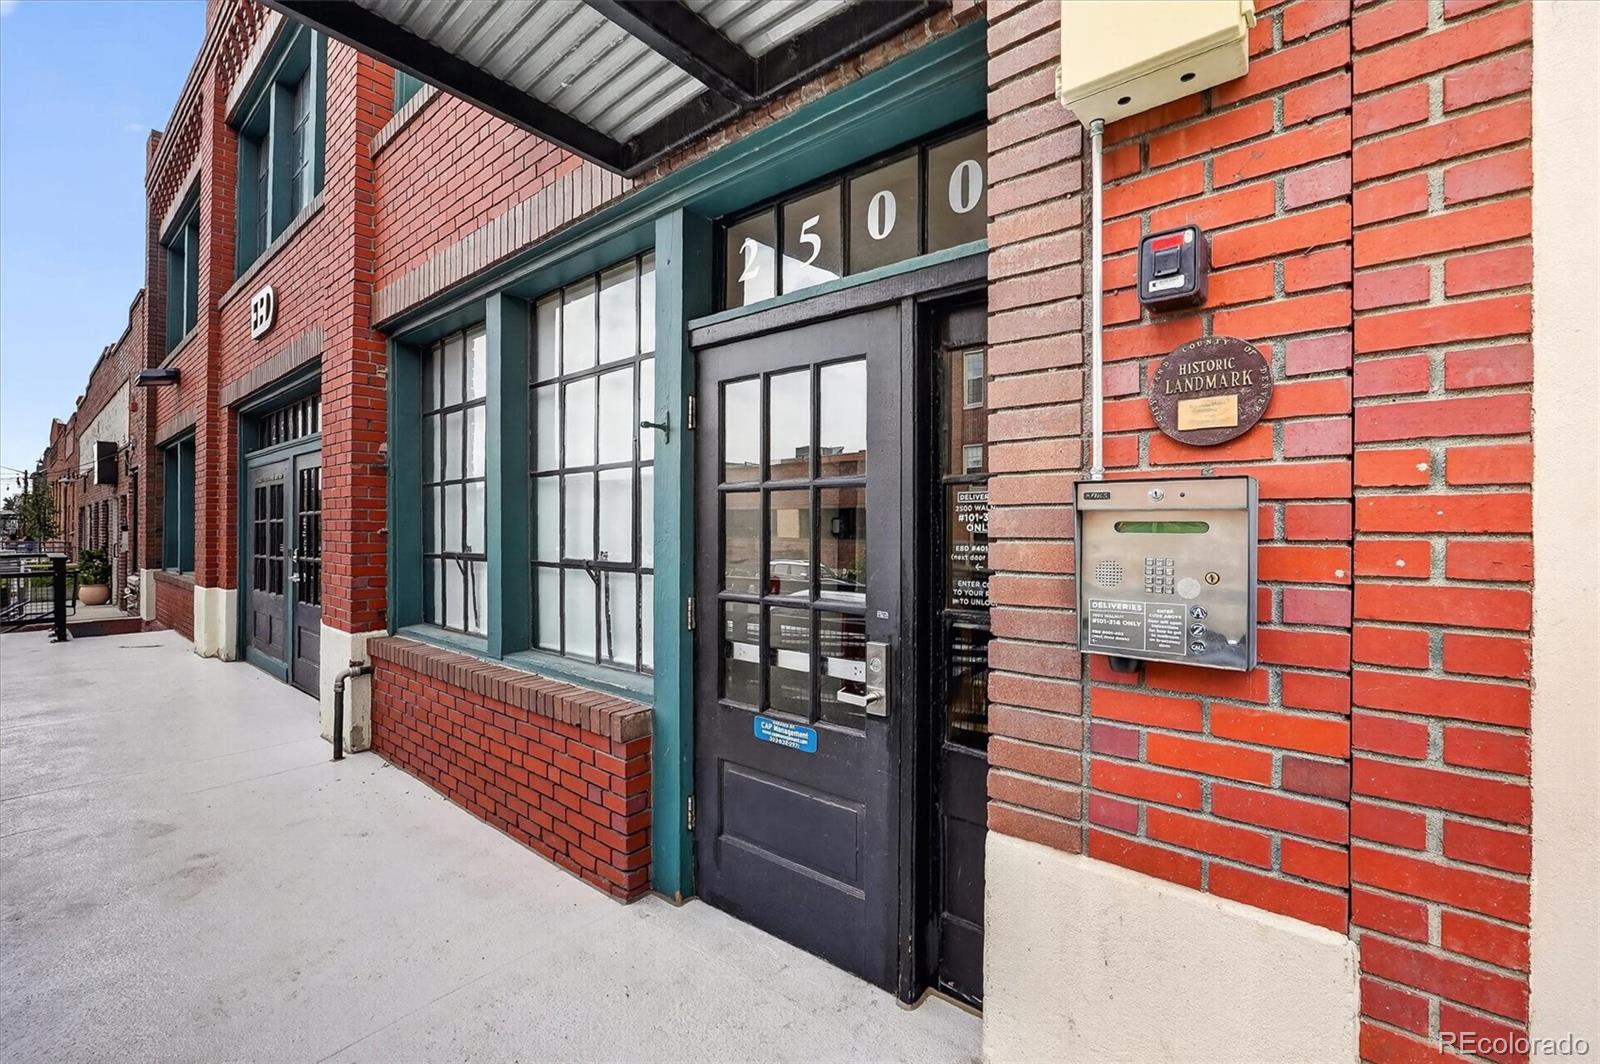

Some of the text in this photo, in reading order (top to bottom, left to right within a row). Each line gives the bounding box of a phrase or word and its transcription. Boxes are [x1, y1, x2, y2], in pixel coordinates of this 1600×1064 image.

[737, 159, 984, 283] 2500
[1182, 338, 1230, 353] COUNTY
[1179, 357, 1236, 376] HISTORIC
[1165, 369, 1254, 394] LANDMARK
[960, 493, 989, 501] DELIVER
[955, 504, 973, 512] 2500
[958, 512, 989, 522] #101-3
[966, 523, 988, 532] ONL
[970, 553, 986, 561] door
[957, 580, 980, 588] ENTER
[1091, 601, 1142, 611] DELIVERIES
[761, 721, 773, 730] CAP
